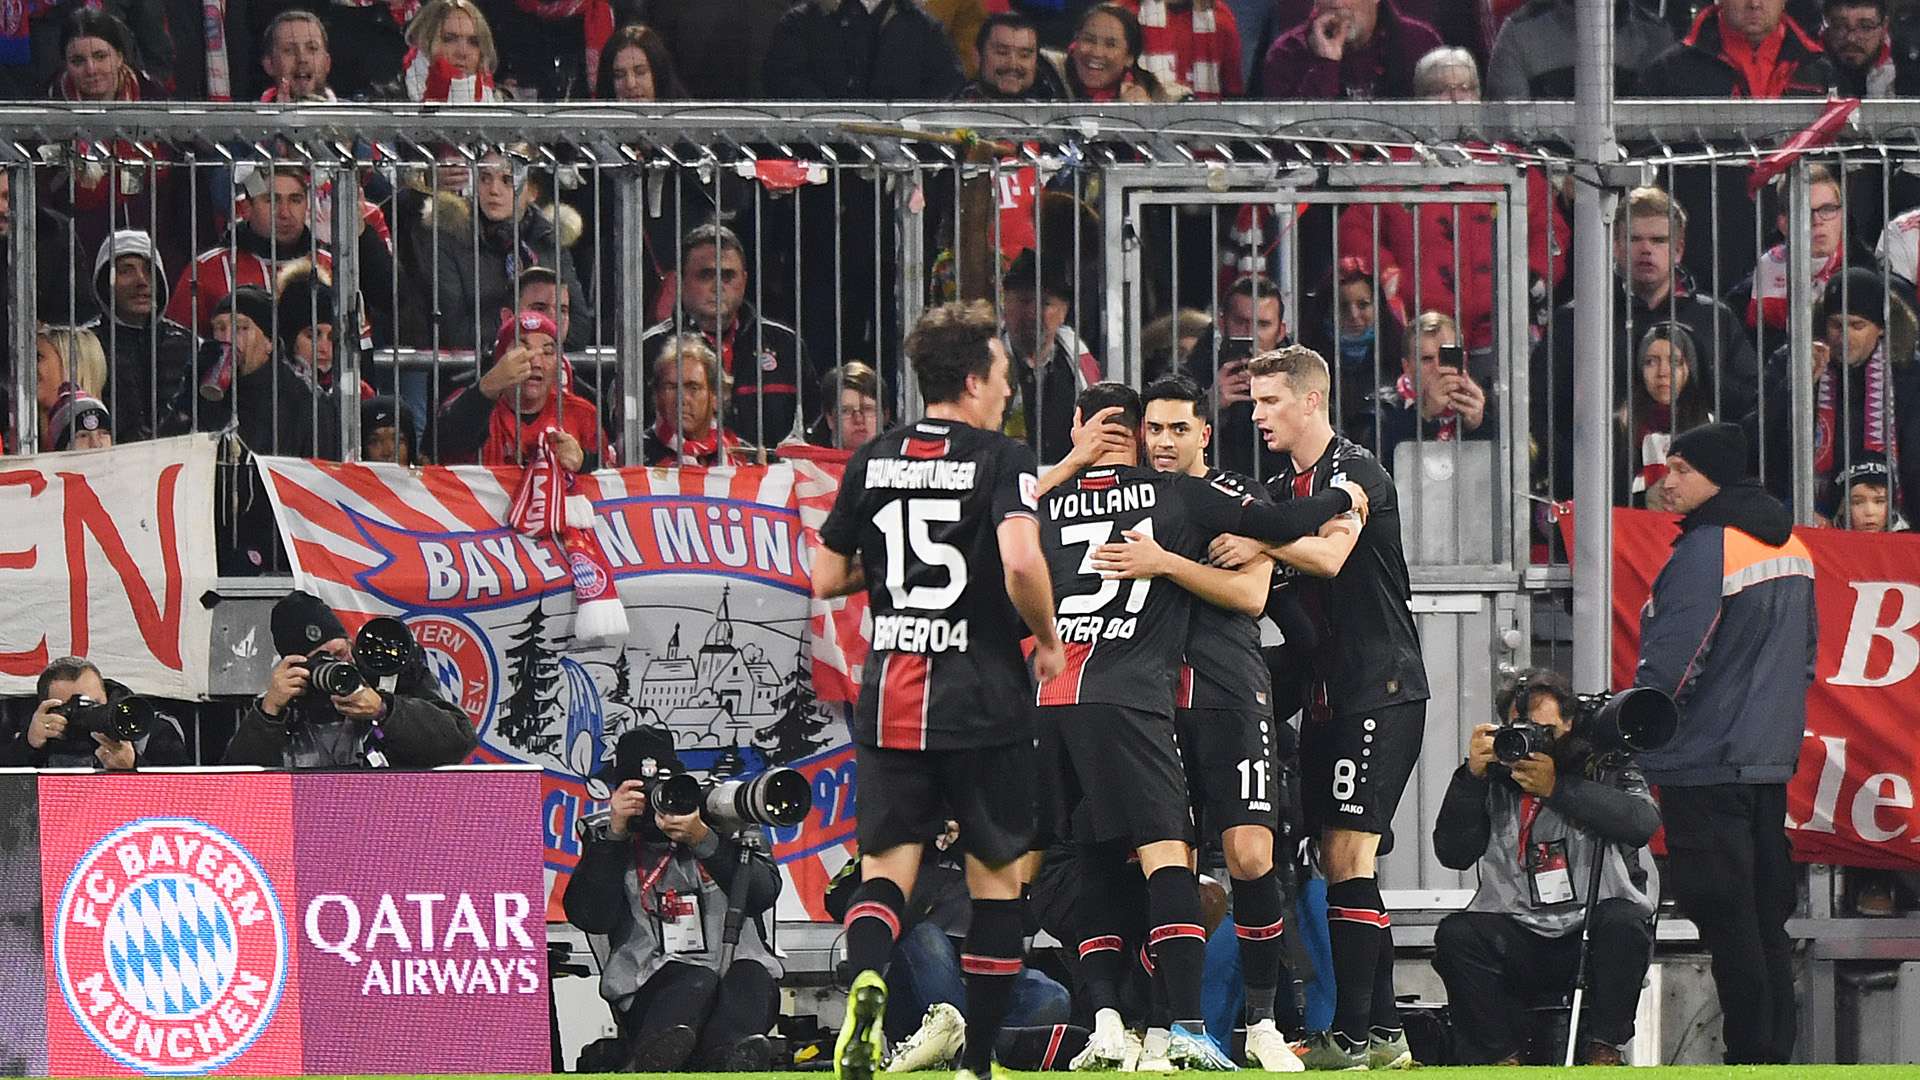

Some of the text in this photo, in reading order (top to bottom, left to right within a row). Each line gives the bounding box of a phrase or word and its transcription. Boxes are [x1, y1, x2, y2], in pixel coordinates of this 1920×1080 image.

[1050, 483, 1156, 520] VOLLAND
[419, 510, 642, 600] BAYEN
[872, 498, 968, 610] 15
[1058, 517, 1154, 614] 31
[1236, 759, 1266, 800] 11
[1332, 758, 1357, 800] 8
[1248, 800, 1271, 812] JAKO
[1339, 803, 1364, 815] JAKO
[72, 835, 265, 928] FC BAYERN
[304, 892, 536, 966] QATAR
[361, 957, 539, 996] AIRWAYS
